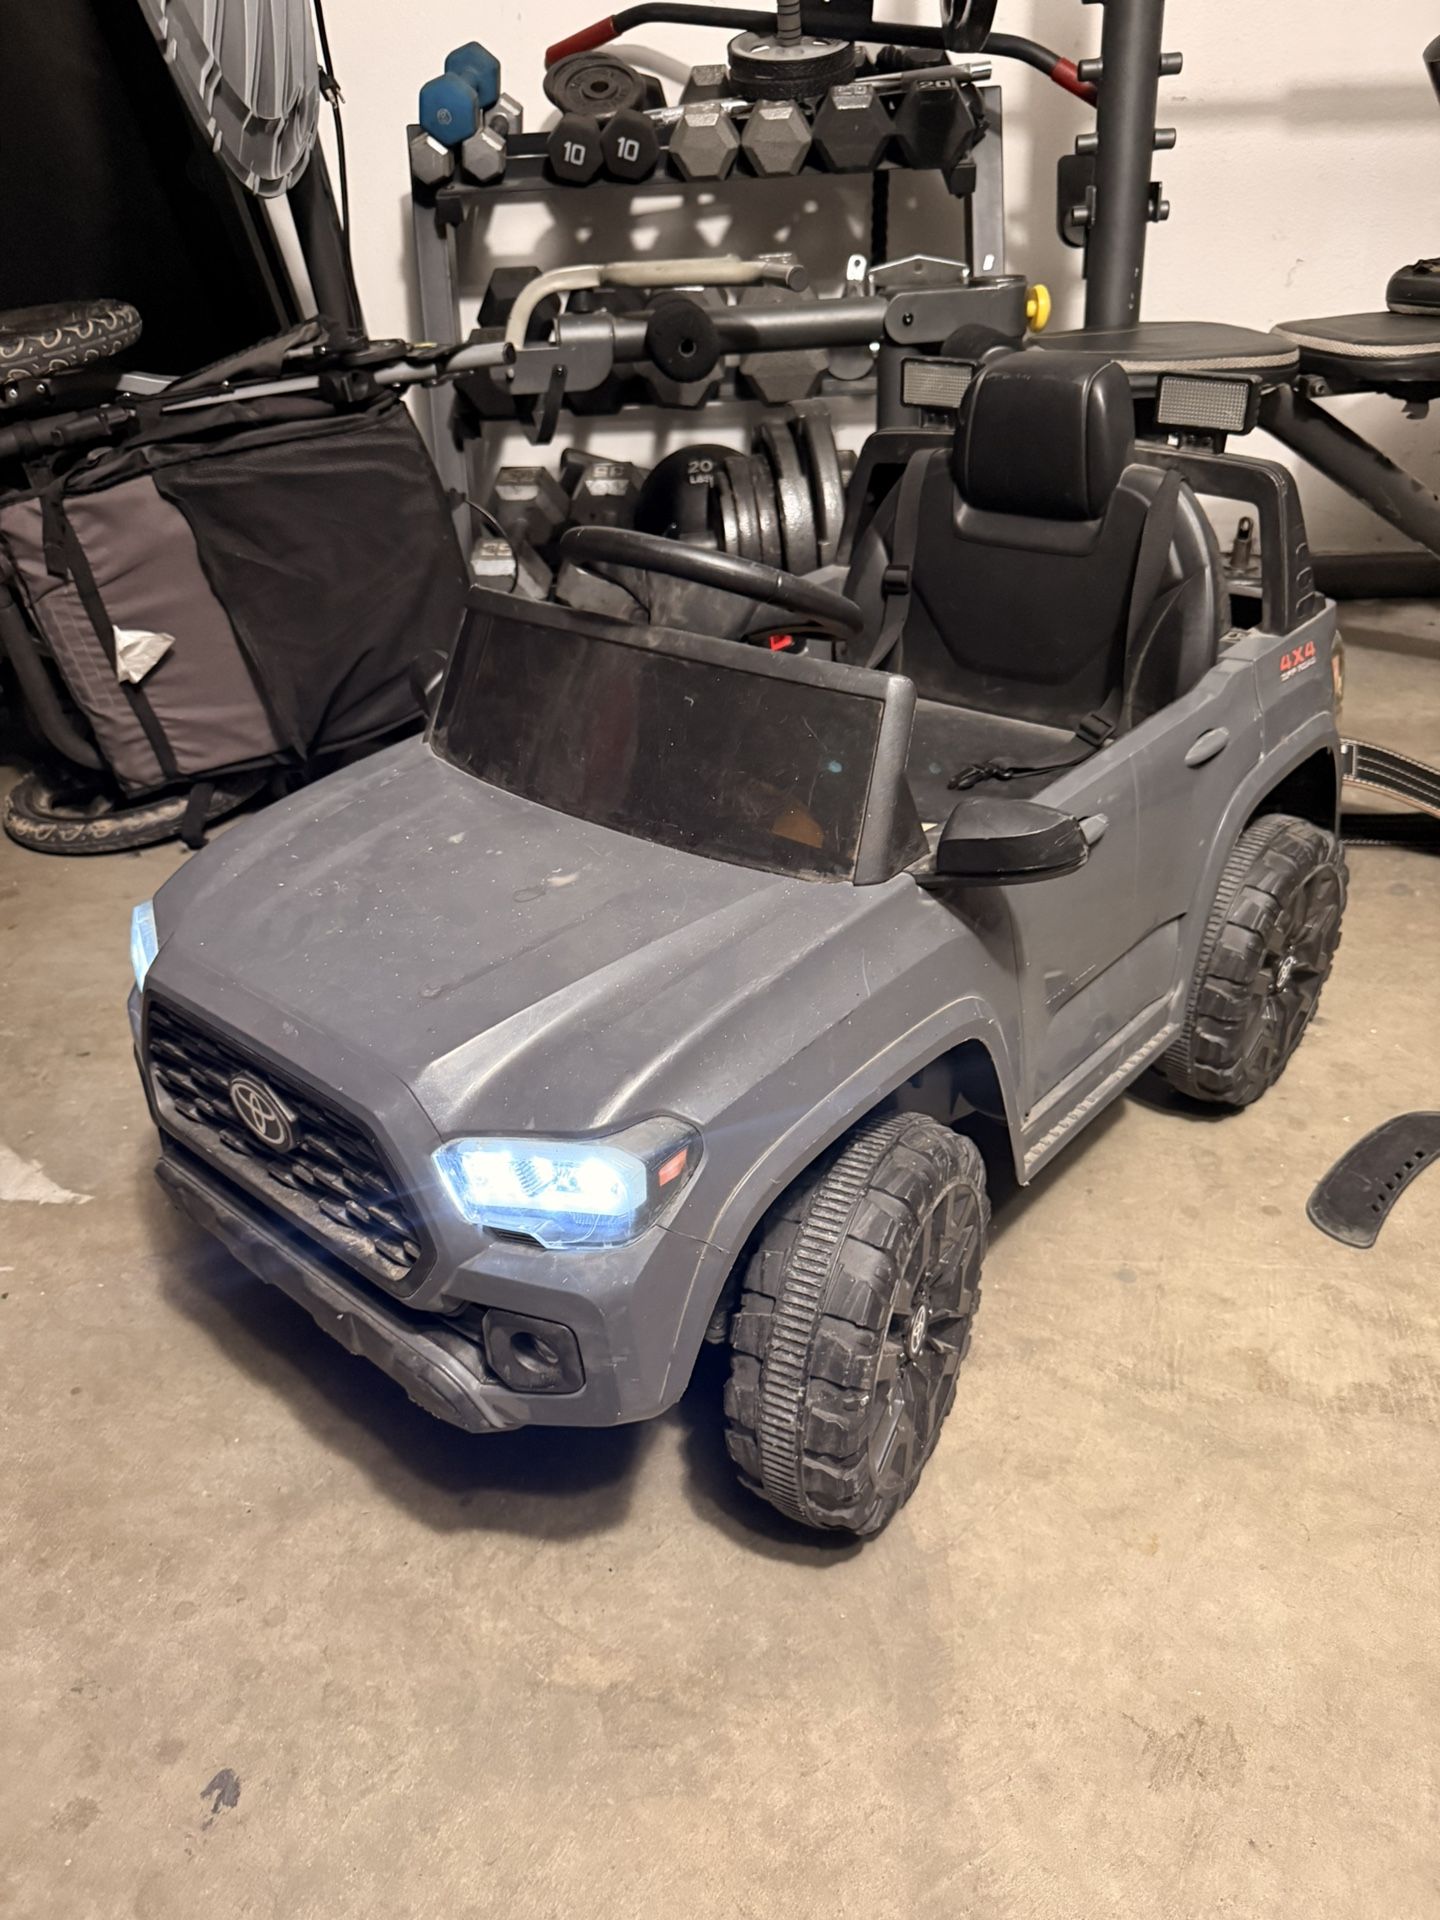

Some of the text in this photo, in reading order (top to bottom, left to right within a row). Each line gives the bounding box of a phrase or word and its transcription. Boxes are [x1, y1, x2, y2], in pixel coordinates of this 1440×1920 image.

[564, 141, 586, 166] 10
[617, 136, 640, 162] 10
[688, 460, 713, 474] 20
